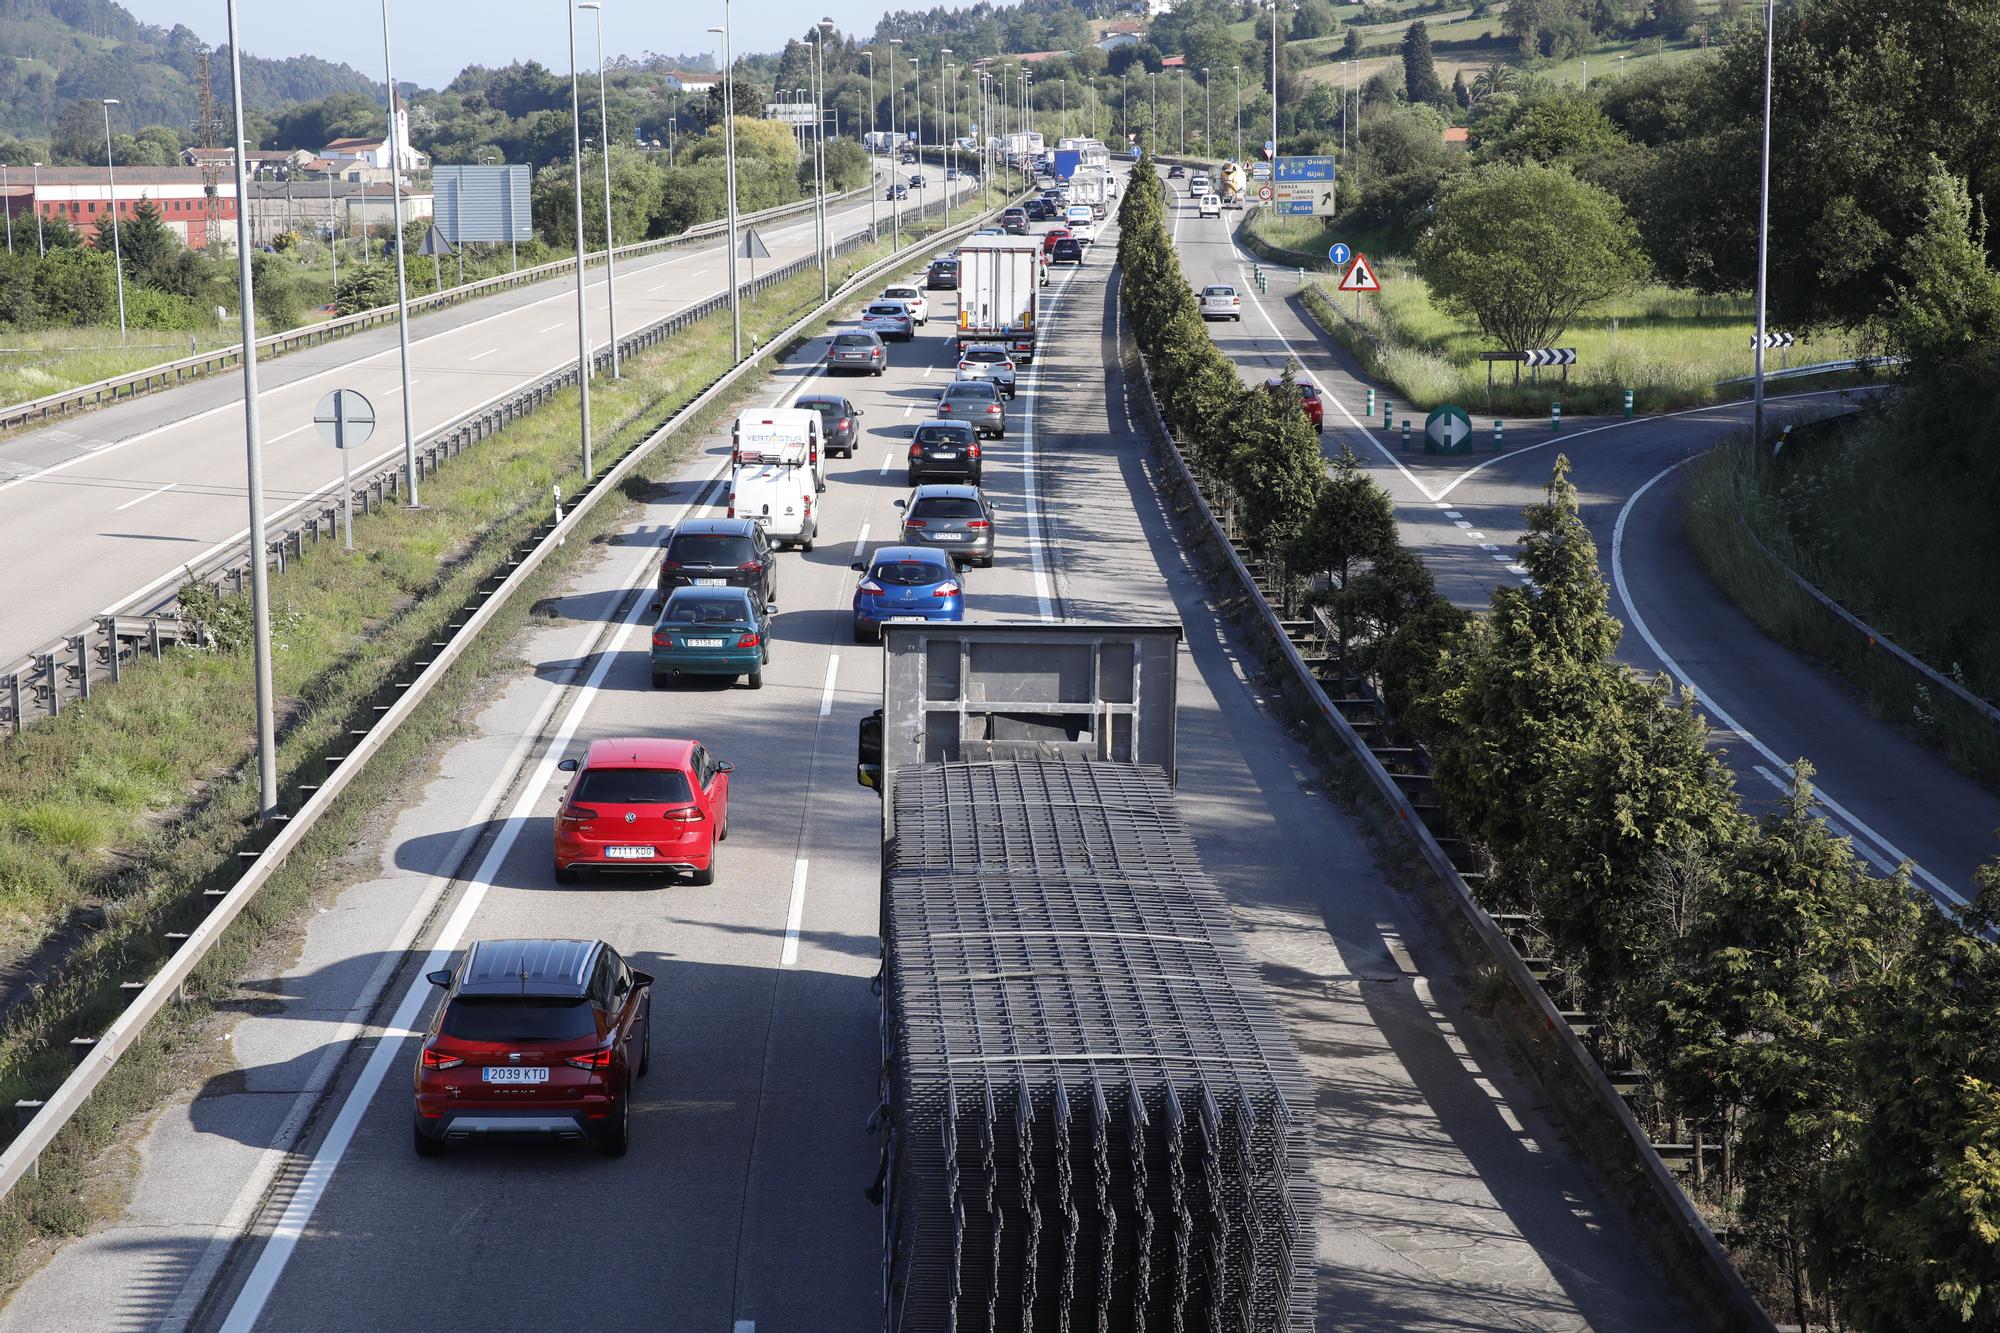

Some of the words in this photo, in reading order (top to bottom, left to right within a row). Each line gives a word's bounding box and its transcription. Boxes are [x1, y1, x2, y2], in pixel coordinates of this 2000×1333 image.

[612, 847, 632, 856] 7111
[491, 1068, 520, 1080] 2039
[524, 1068, 546, 1080] KTD
